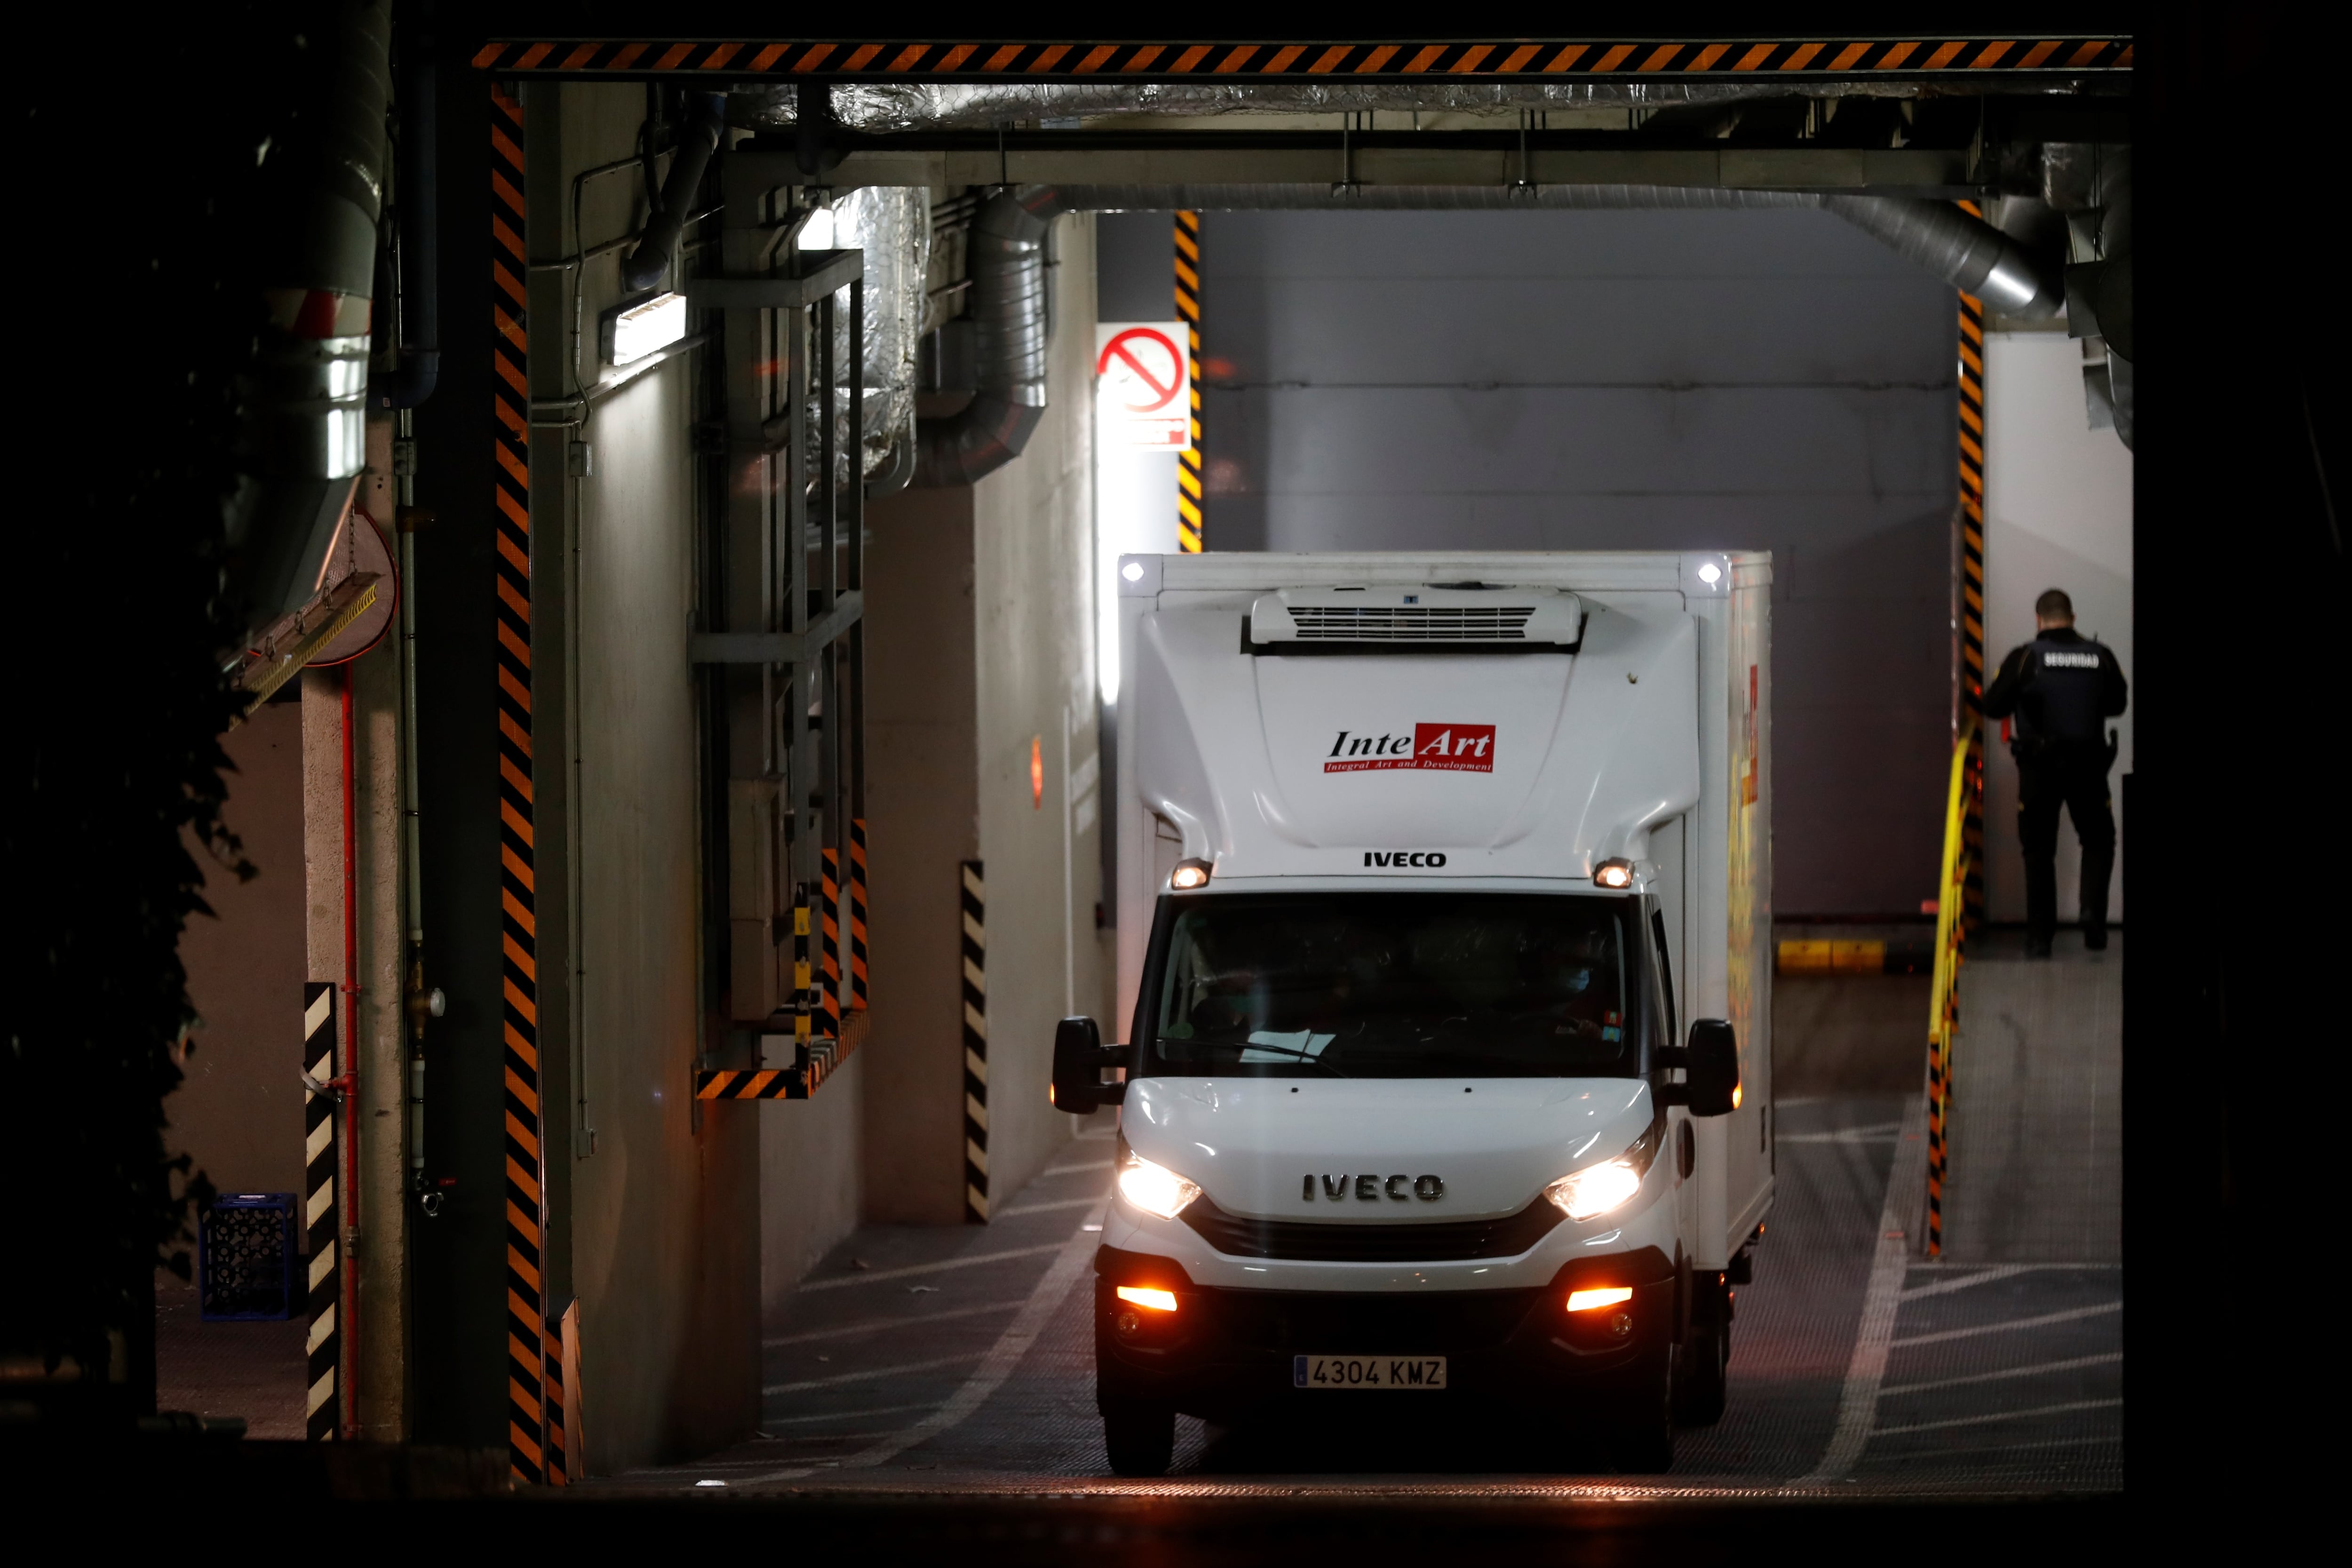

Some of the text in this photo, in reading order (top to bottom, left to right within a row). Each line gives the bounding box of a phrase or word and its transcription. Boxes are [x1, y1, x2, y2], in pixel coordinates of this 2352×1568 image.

[2044, 652, 2099, 669] SEGURIDAD
[1327, 761, 1369, 772] Integral
[1423, 760, 1492, 771] Development
[1364, 852, 1446, 867] IVECO
[1303, 1174, 1444, 1202] IVECO
[1314, 1361, 1379, 1384] 4304
[1391, 1361, 1440, 1385] KMZ
